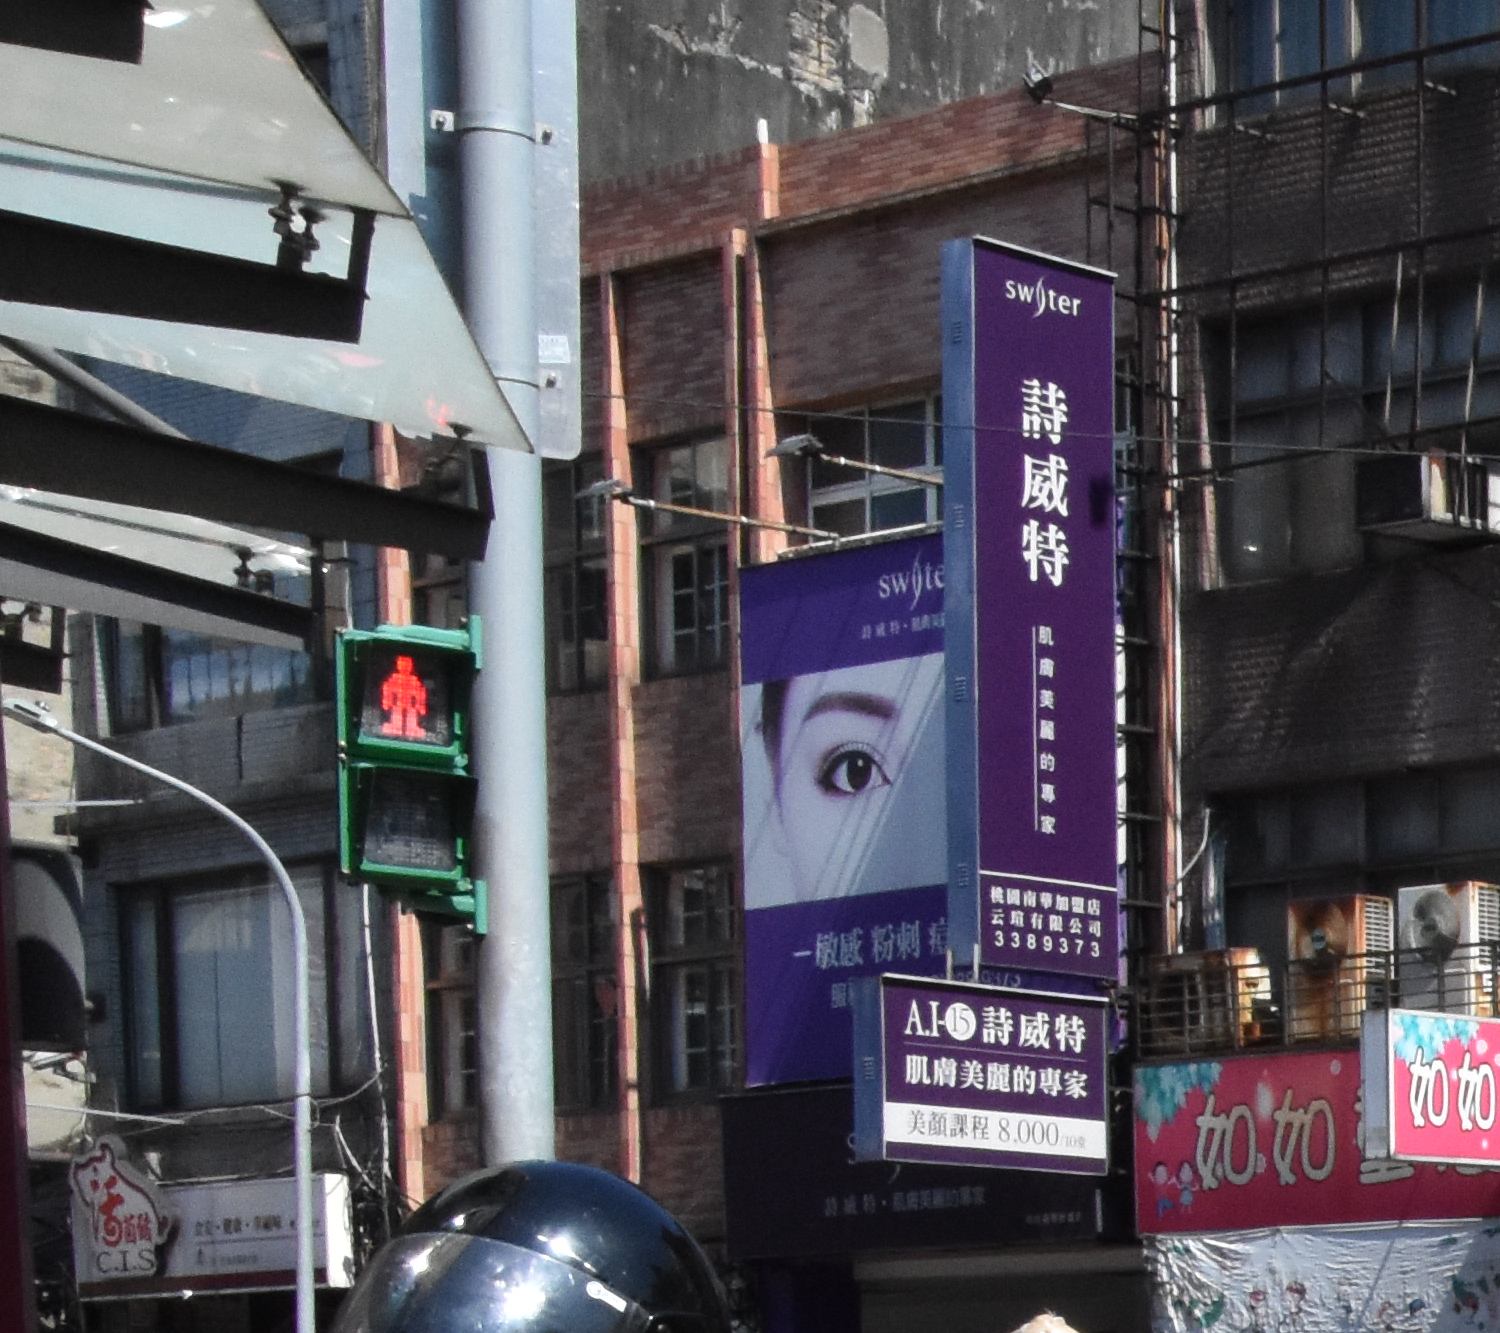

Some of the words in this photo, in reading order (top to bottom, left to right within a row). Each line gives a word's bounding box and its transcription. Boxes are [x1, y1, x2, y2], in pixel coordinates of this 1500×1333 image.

[1020, 378, 1070, 588] 詩威特
[1038, 625, 1056, 835] 肌膚美麗的專家
[990, 885, 1100, 917] 桃園南華加盟店
[995, 931, 1100, 958] 3389373
[981, 1006, 1086, 1054] 詩威特
[905, 1054, 1088, 1099] 肌膚美麗的專家
[907, 1110, 989, 1141] 美顏課程
[96, 1250, 156, 1273] C.I.S
